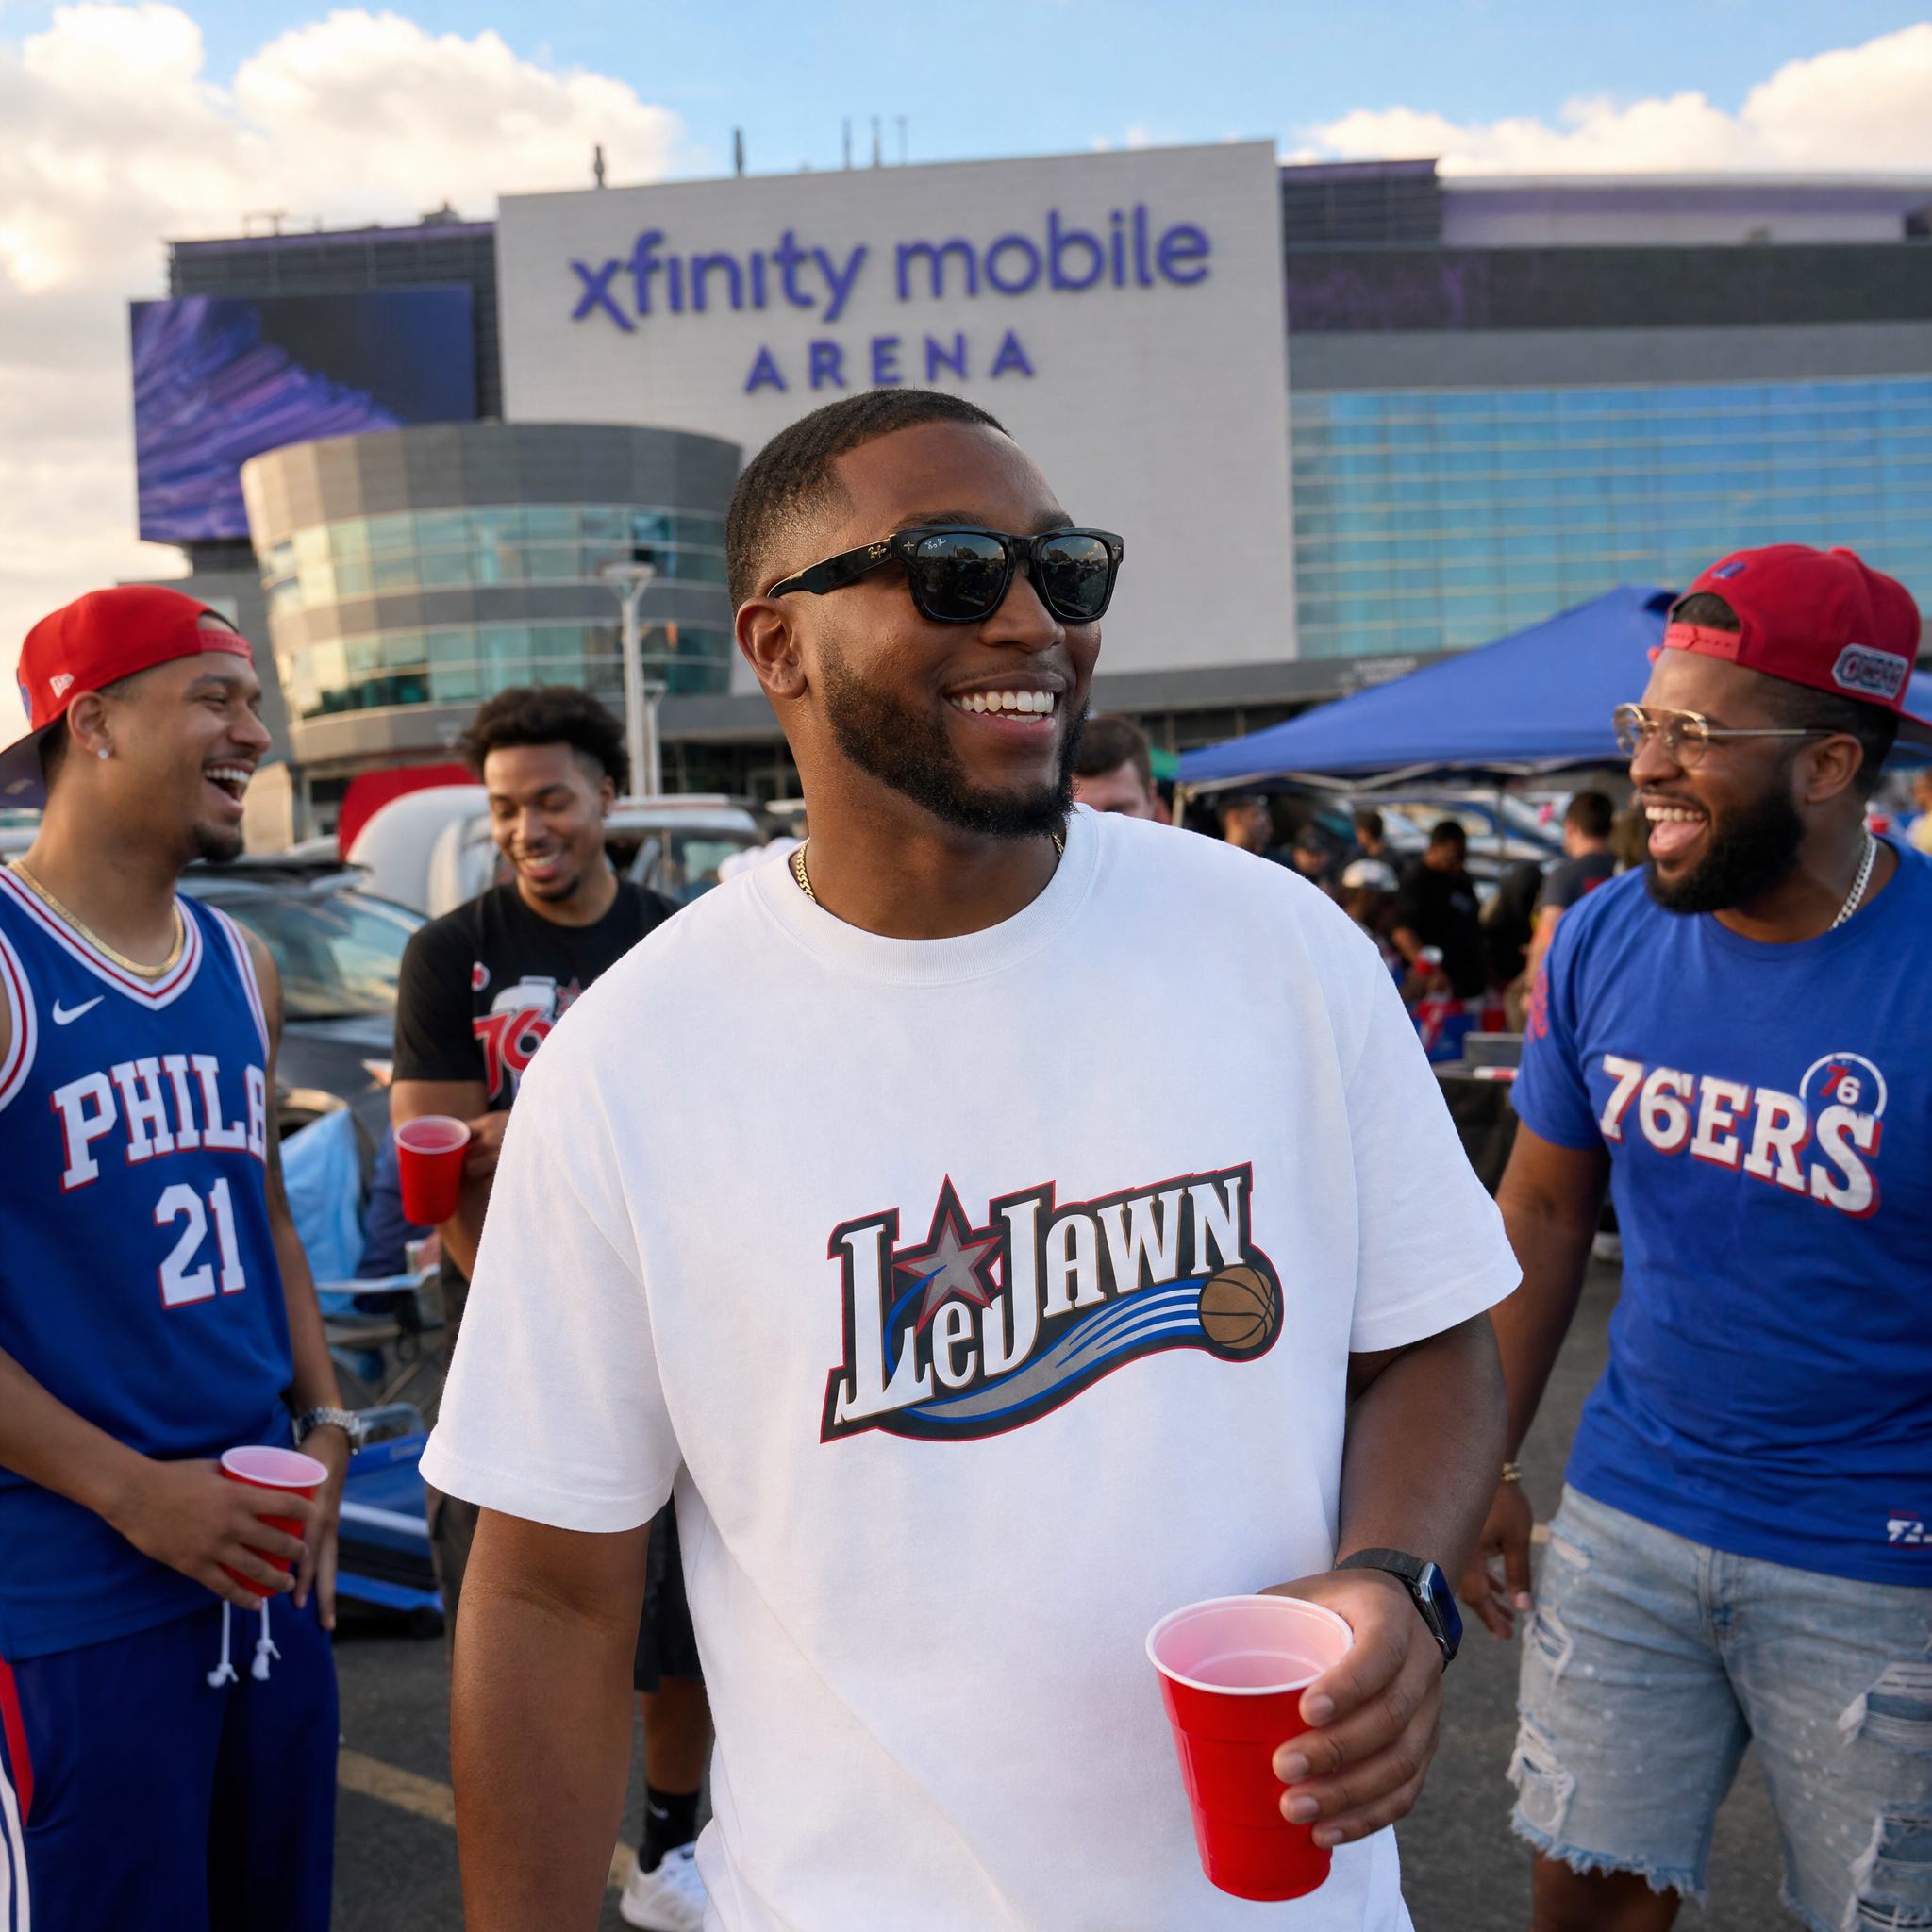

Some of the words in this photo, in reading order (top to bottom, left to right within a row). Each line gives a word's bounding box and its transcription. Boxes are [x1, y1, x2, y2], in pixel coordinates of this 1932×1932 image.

[569, 227, 869, 333] xfinity
[894, 203, 1213, 303] mobile
[743, 328, 1036, 394] ARENA
[472, 1005, 557, 1102] 76
[1819, 1064, 1862, 1106] 76
[1599, 1053, 1883, 1219] 76ERS
[153, 1176, 247, 1311] 21
